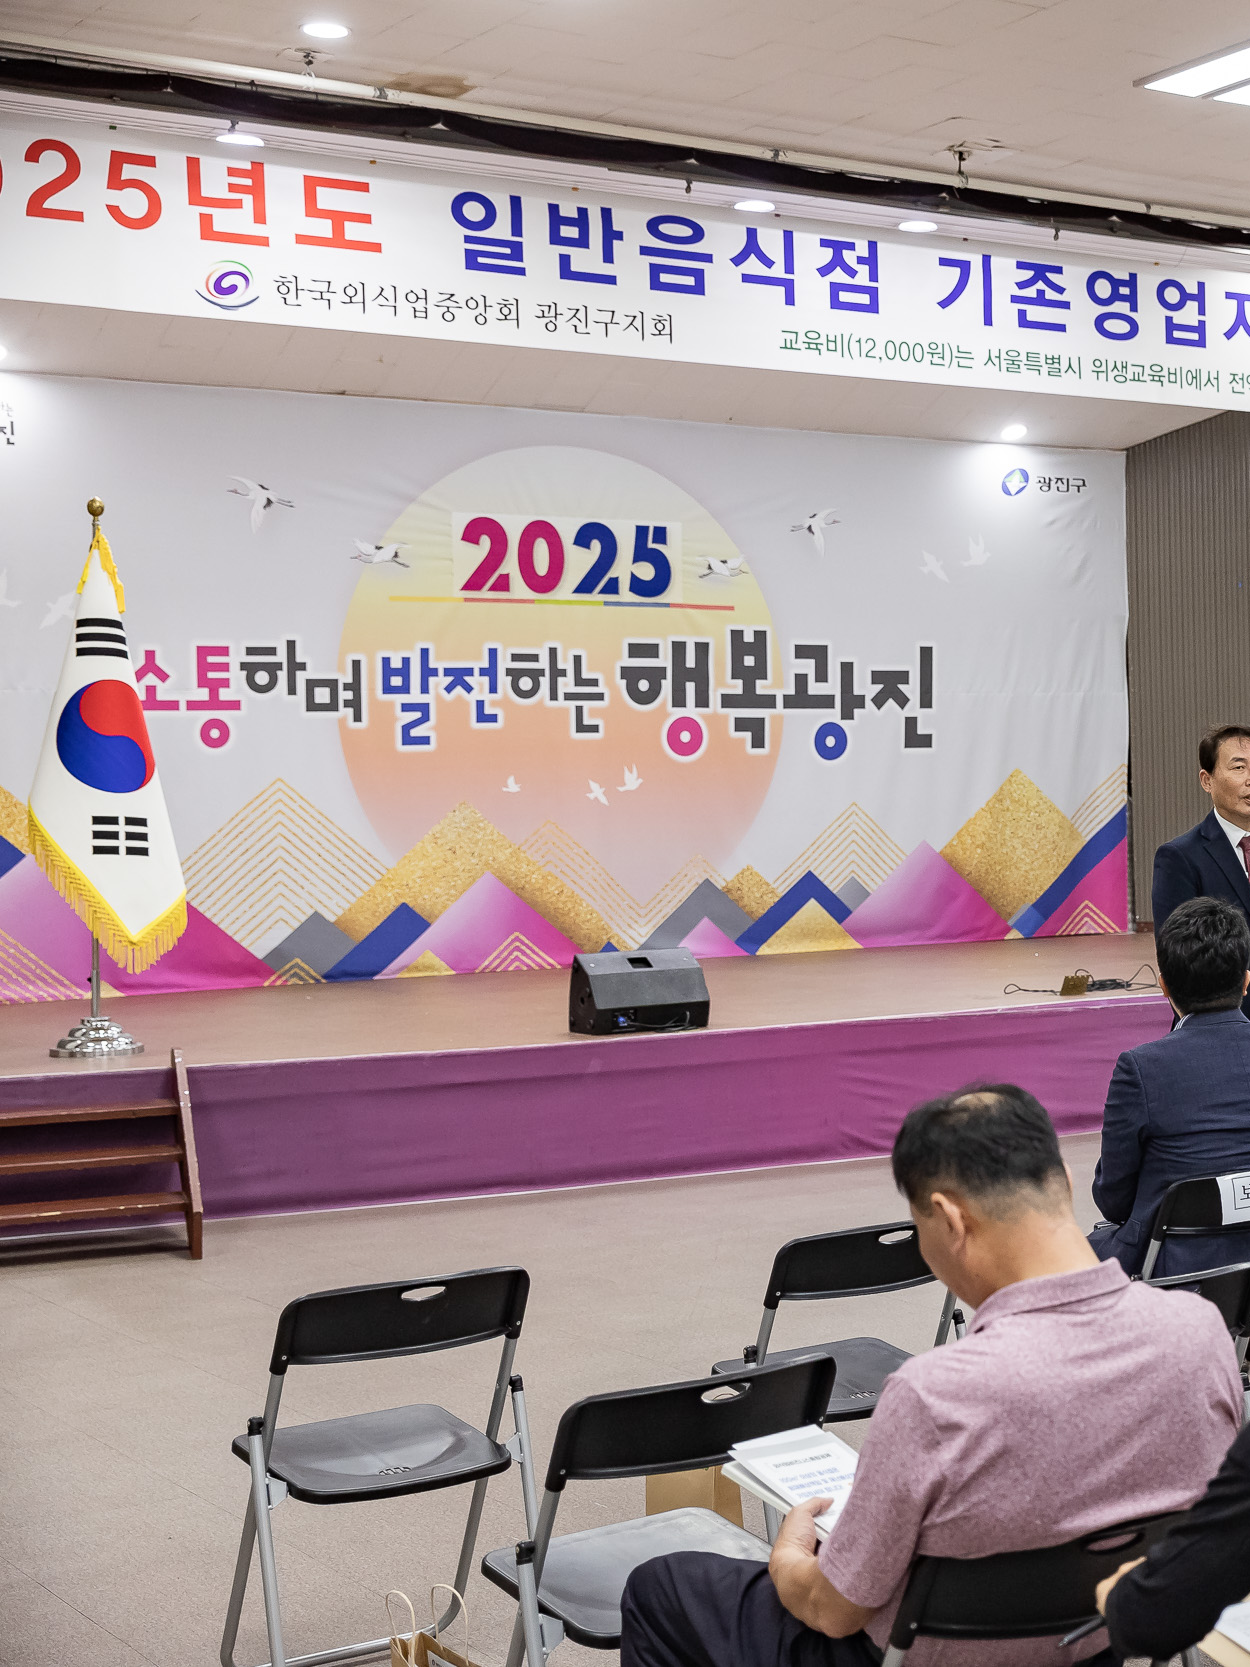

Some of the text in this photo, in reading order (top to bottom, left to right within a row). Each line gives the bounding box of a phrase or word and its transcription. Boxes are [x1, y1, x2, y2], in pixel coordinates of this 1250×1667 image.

[0, 138, 382, 253] 25년도
[451, 191, 880, 314] 일반음식점
[273, 274, 674, 344] 한국외식업중앙회 광진구지회
[779, 329, 975, 370] 교육비(12,000원)는
[984, 347, 1082, 379] 서울특별시
[1091, 358, 1221, 393] 위생교육비에서
[1035, 475, 1087, 493] 광진구
[459, 516, 673, 598] 2025
[134, 629, 933, 761] 소통하며 발전하는 행복광진
